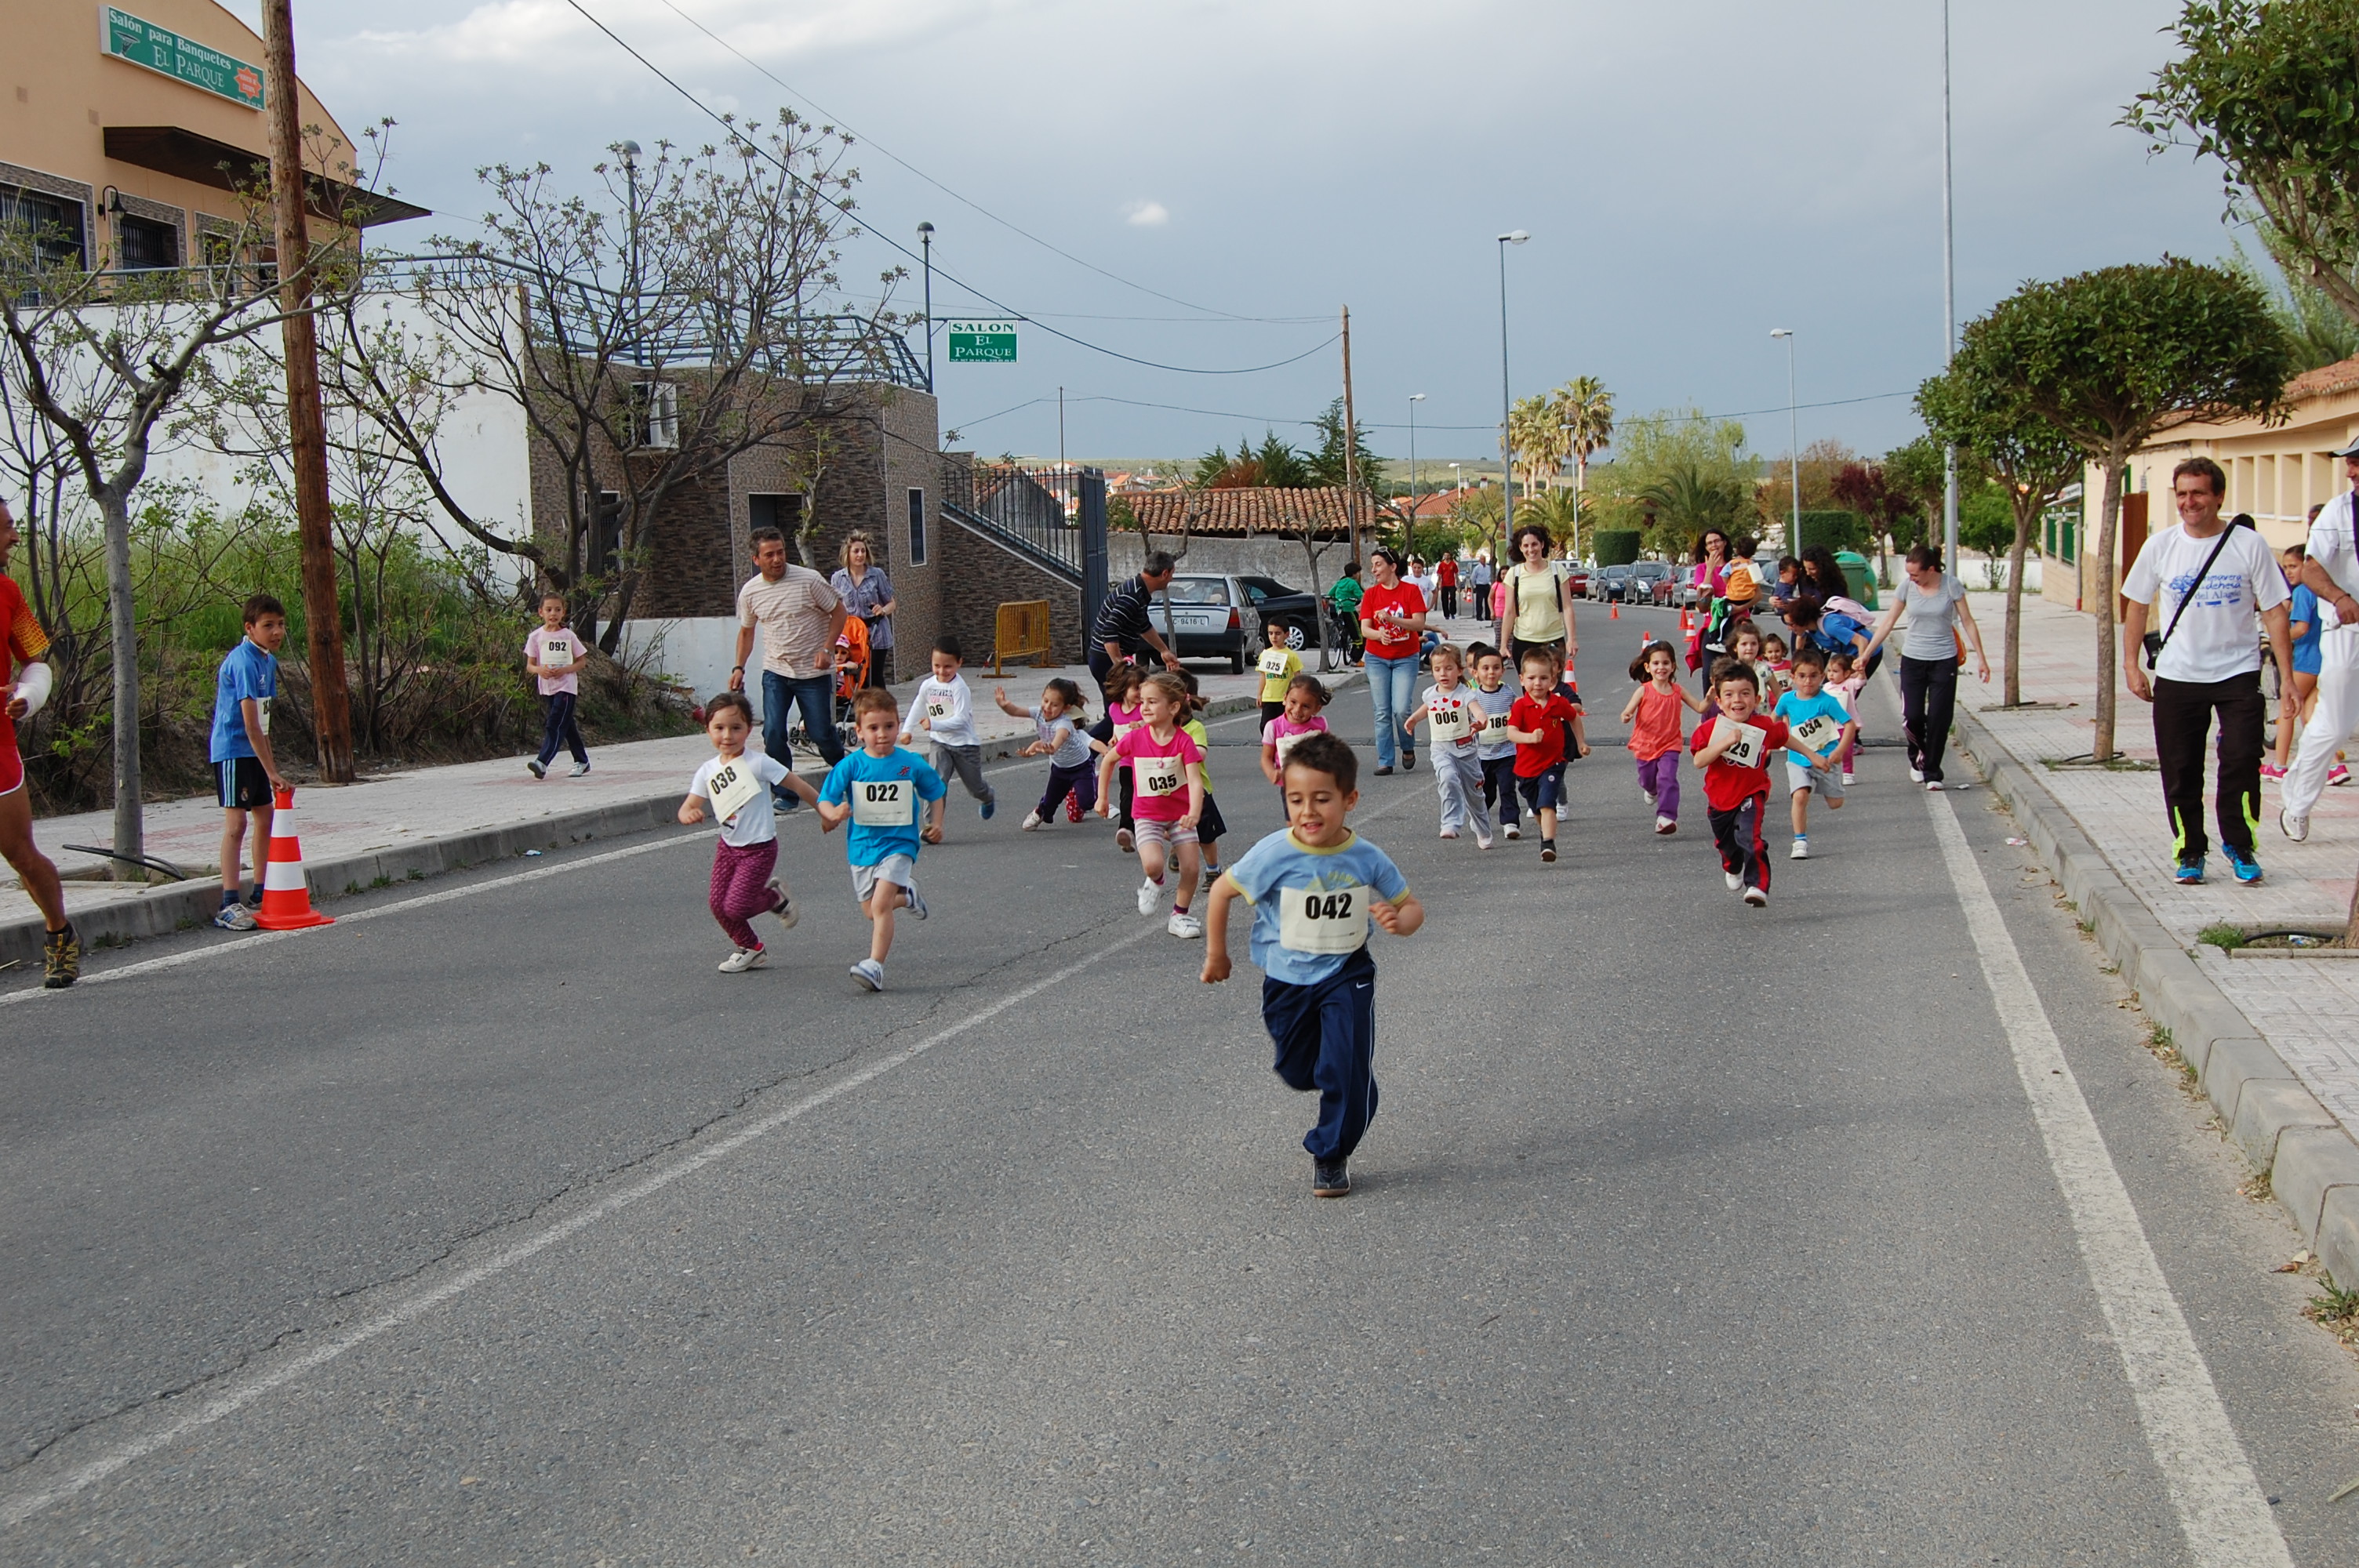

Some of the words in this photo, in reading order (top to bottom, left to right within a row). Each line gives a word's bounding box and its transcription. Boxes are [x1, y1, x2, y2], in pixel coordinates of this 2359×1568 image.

[110, 10, 142, 34] Salón
[149, 28, 173, 46] para
[177, 38, 231, 70] Banquetes
[952, 323, 1013, 332] SALON
[954, 347, 1012, 359] PARQUE
[549, 641, 566, 652] 092
[1434, 711, 1459, 725] 006
[1489, 715, 1508, 729] 186
[1798, 718, 1823, 738] 034
[711, 765, 737, 795] 038
[1148, 773, 1177, 791] 035
[866, 784, 899, 802] 022
[1305, 892, 1353, 920] 042
